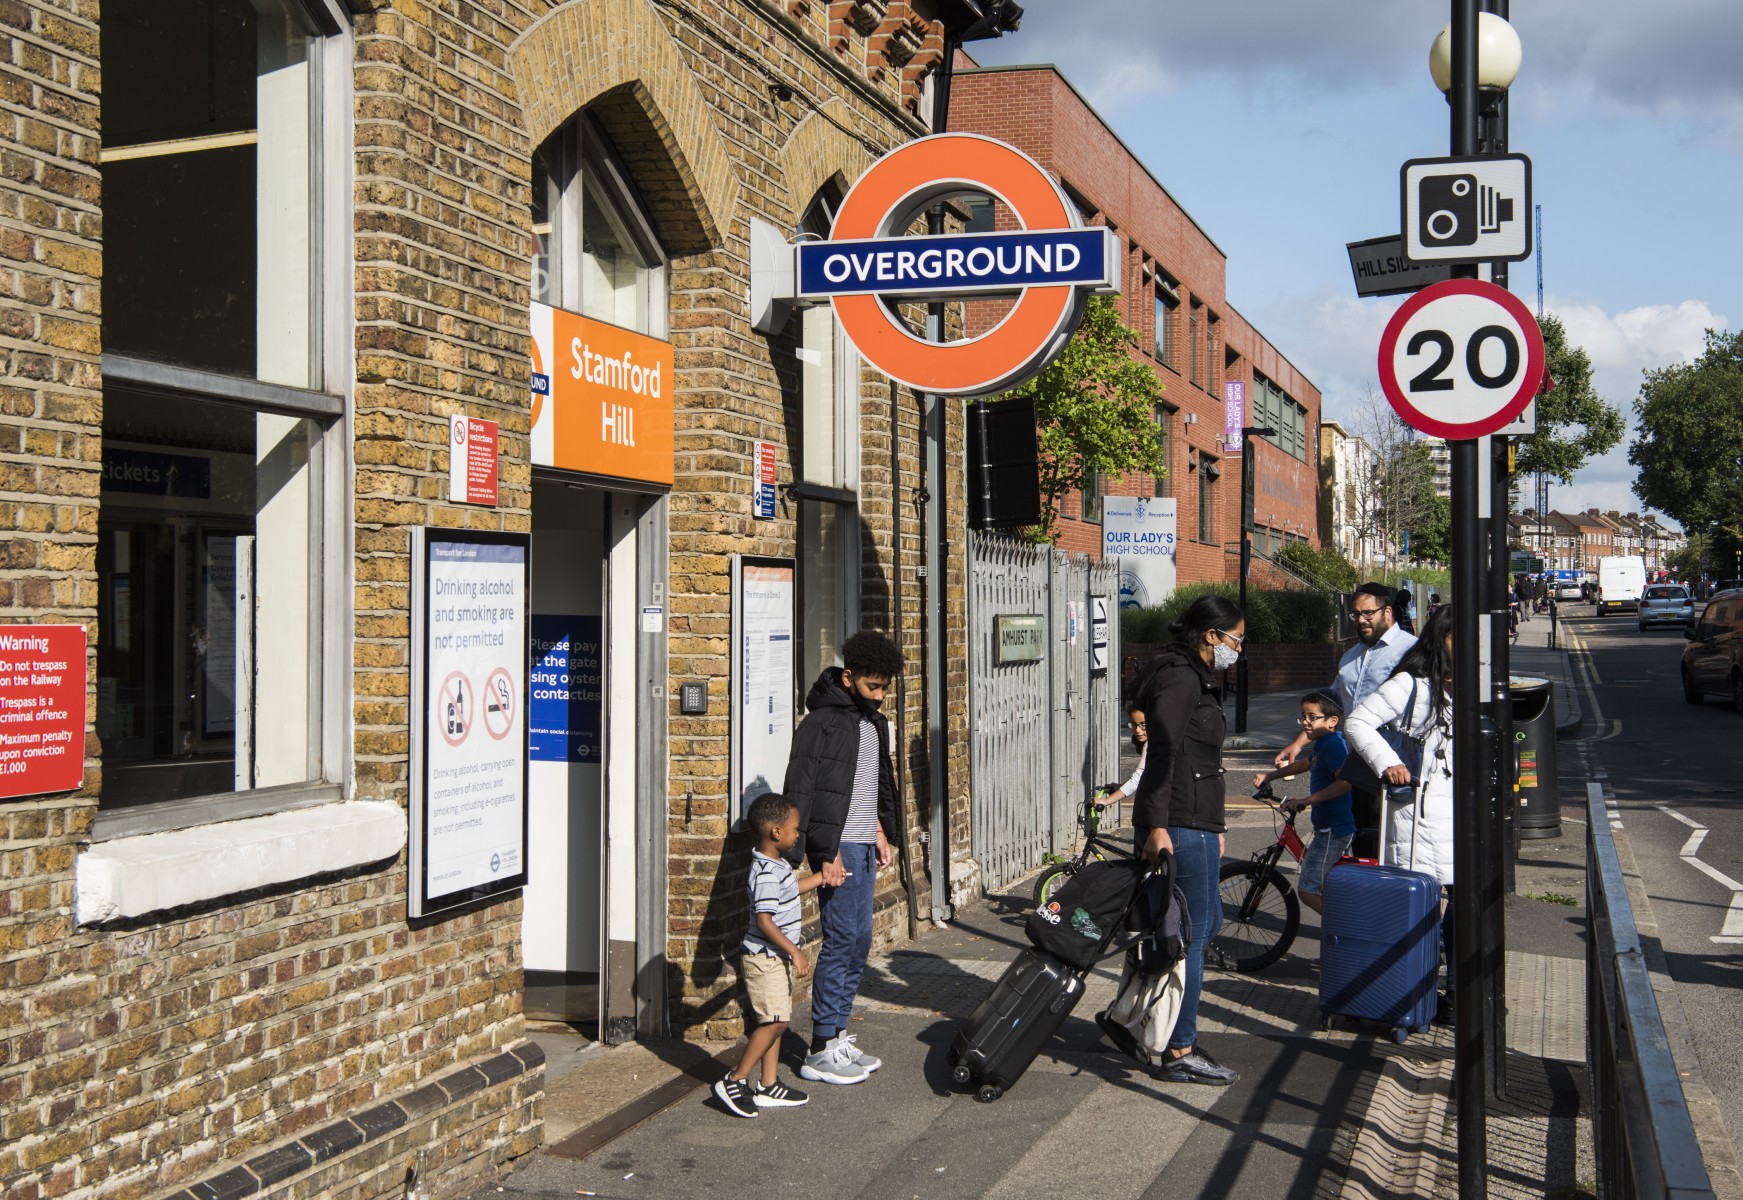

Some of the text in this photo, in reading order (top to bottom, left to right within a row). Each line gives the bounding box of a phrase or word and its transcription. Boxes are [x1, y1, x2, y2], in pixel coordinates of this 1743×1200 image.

[823, 244, 1080, 282] OVERGROUND
[1406, 325, 1520, 392] 20
[571, 336, 660, 398] Stamford
[602, 401, 634, 447] Hill
[1106, 532, 1173, 543] OUR LADY'S
[1106, 545, 1173, 555] HIGH SCHOOL
[436, 578, 514, 599] Drinking alcohol
[435, 604, 514, 624] and smoking are
[0, 635, 48, 653] Warning
[435, 630, 504, 652] not permitted
[1002, 629, 1042, 646] AMHURST PARK
[531, 638, 597, 654] Please pay
[0, 661, 67, 672] Do not trespass
[544, 655, 566, 667] the
[570, 657, 597, 670] gate
[0, 674, 62, 686] on the Railway
[560, 674, 600, 686] oyster
[0, 696, 53, 710] Trespass is a
[0, 710, 68, 723] criminal offence
[0, 730, 72, 744] Maximum penalty
[0, 745, 64, 762] upon conviction
[434, 768, 458, 779] Drinking
[481, 760, 501, 772] carrying
[502, 758, 515, 768] open
[434, 786, 464, 799] containers
[465, 784, 471, 793] of
[494, 778, 504, 788] and
[460, 799, 484, 812] including
[433, 826, 443, 835] are
[444, 823, 454, 833] not
